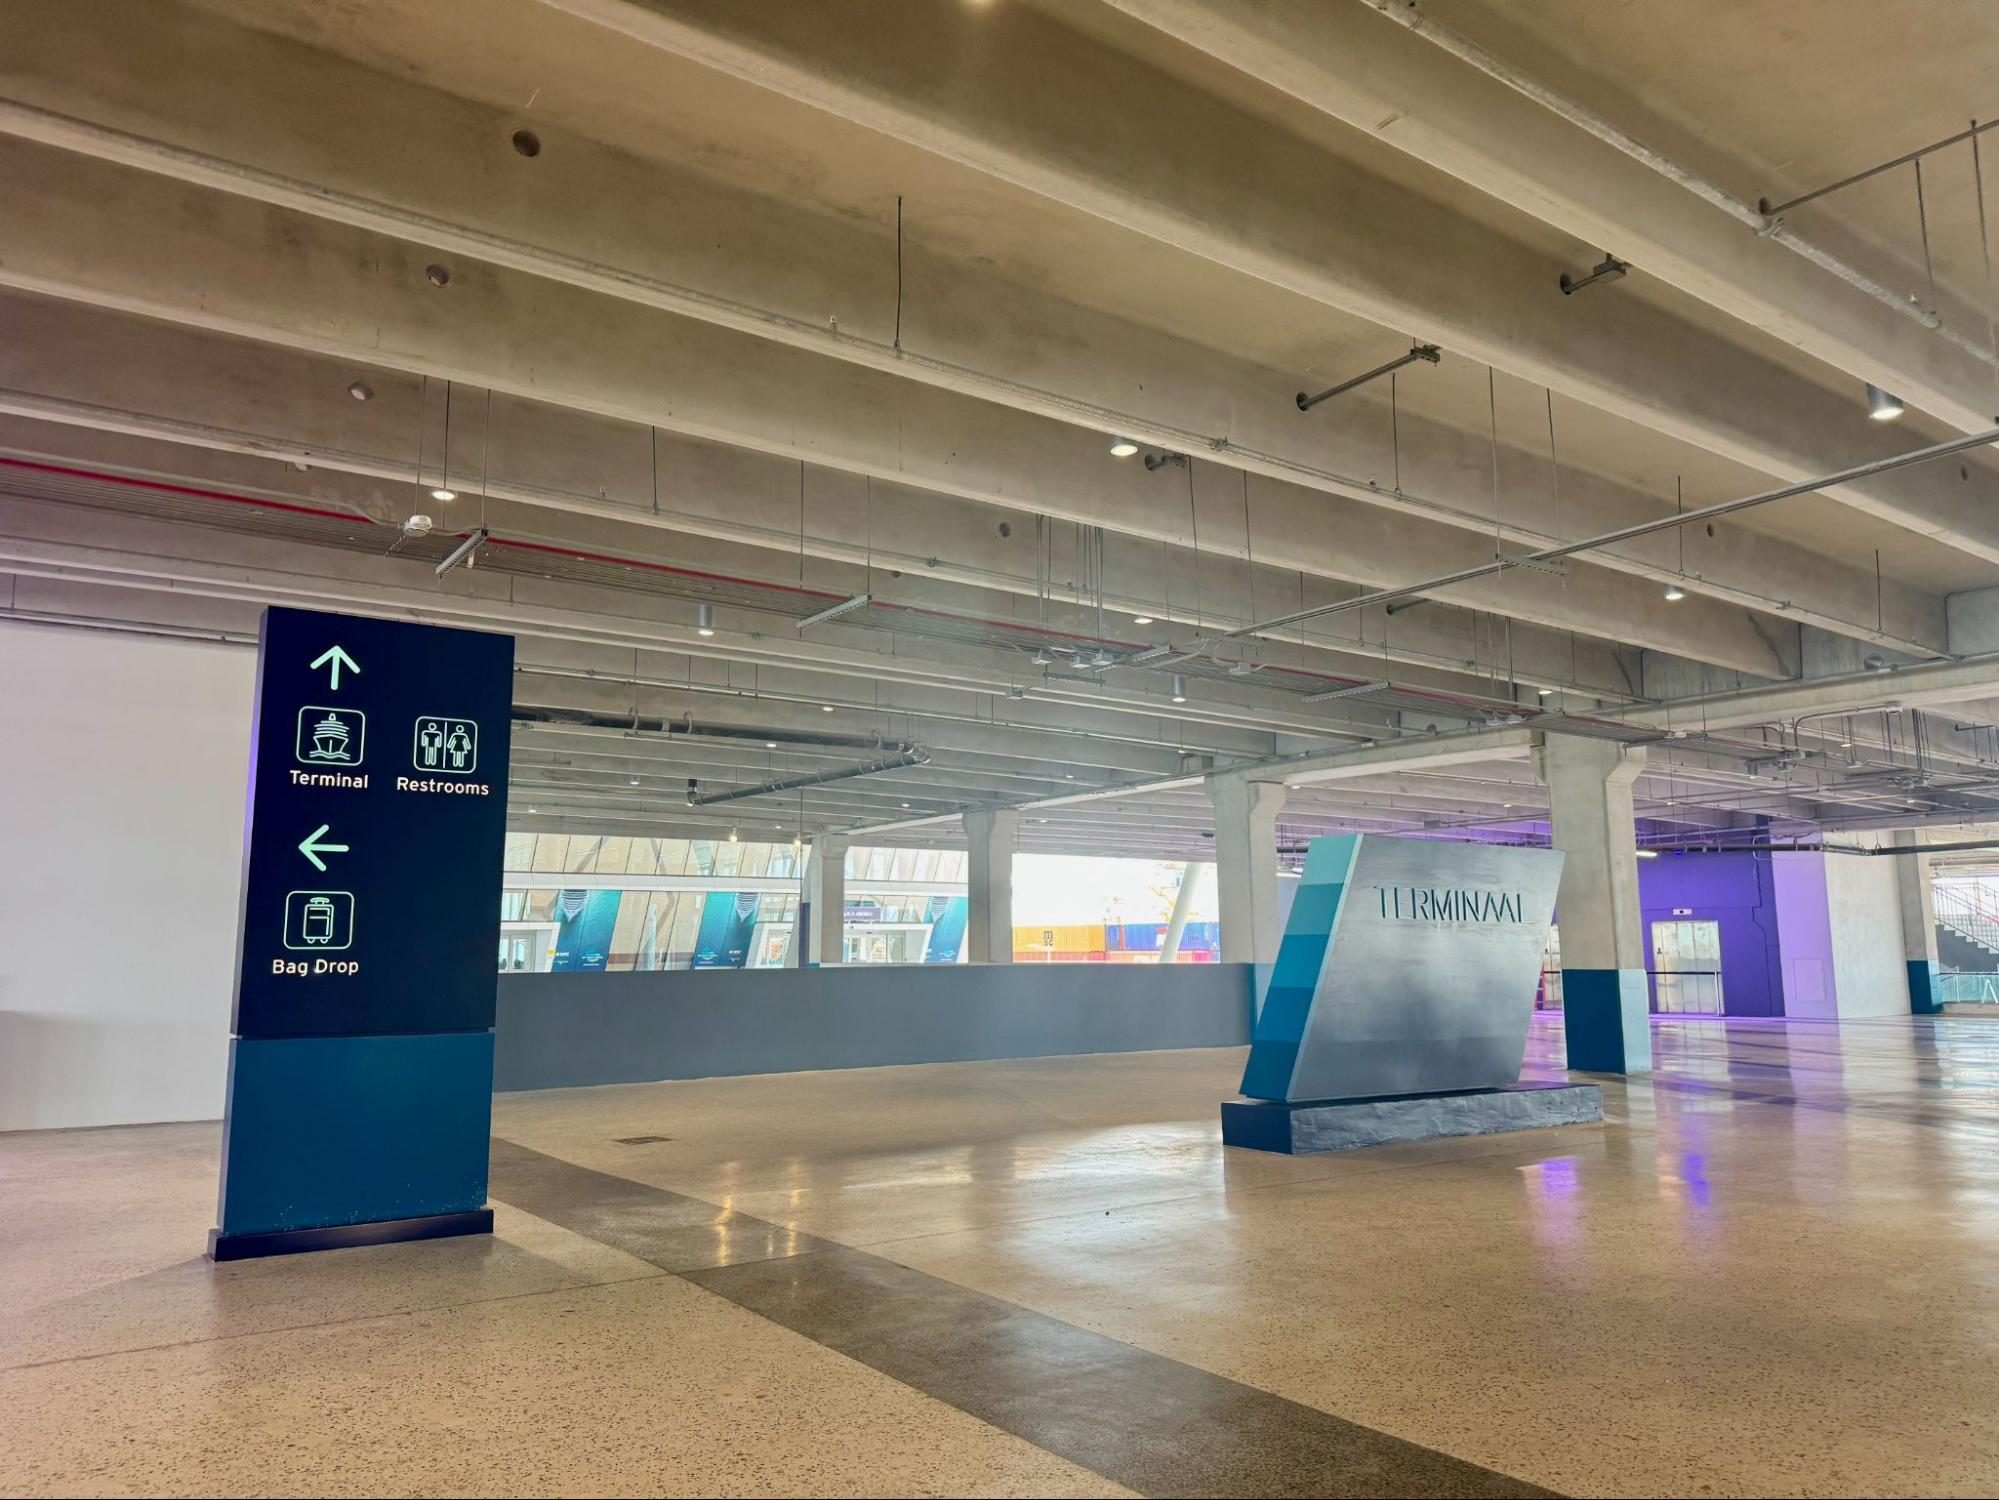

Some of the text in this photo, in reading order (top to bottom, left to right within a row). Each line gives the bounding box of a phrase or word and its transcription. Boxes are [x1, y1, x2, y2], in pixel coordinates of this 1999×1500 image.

[289, 769, 368, 789] Terminal
[396, 776, 491, 796] Restrooms
[272, 958, 359, 977] Bag Drop
